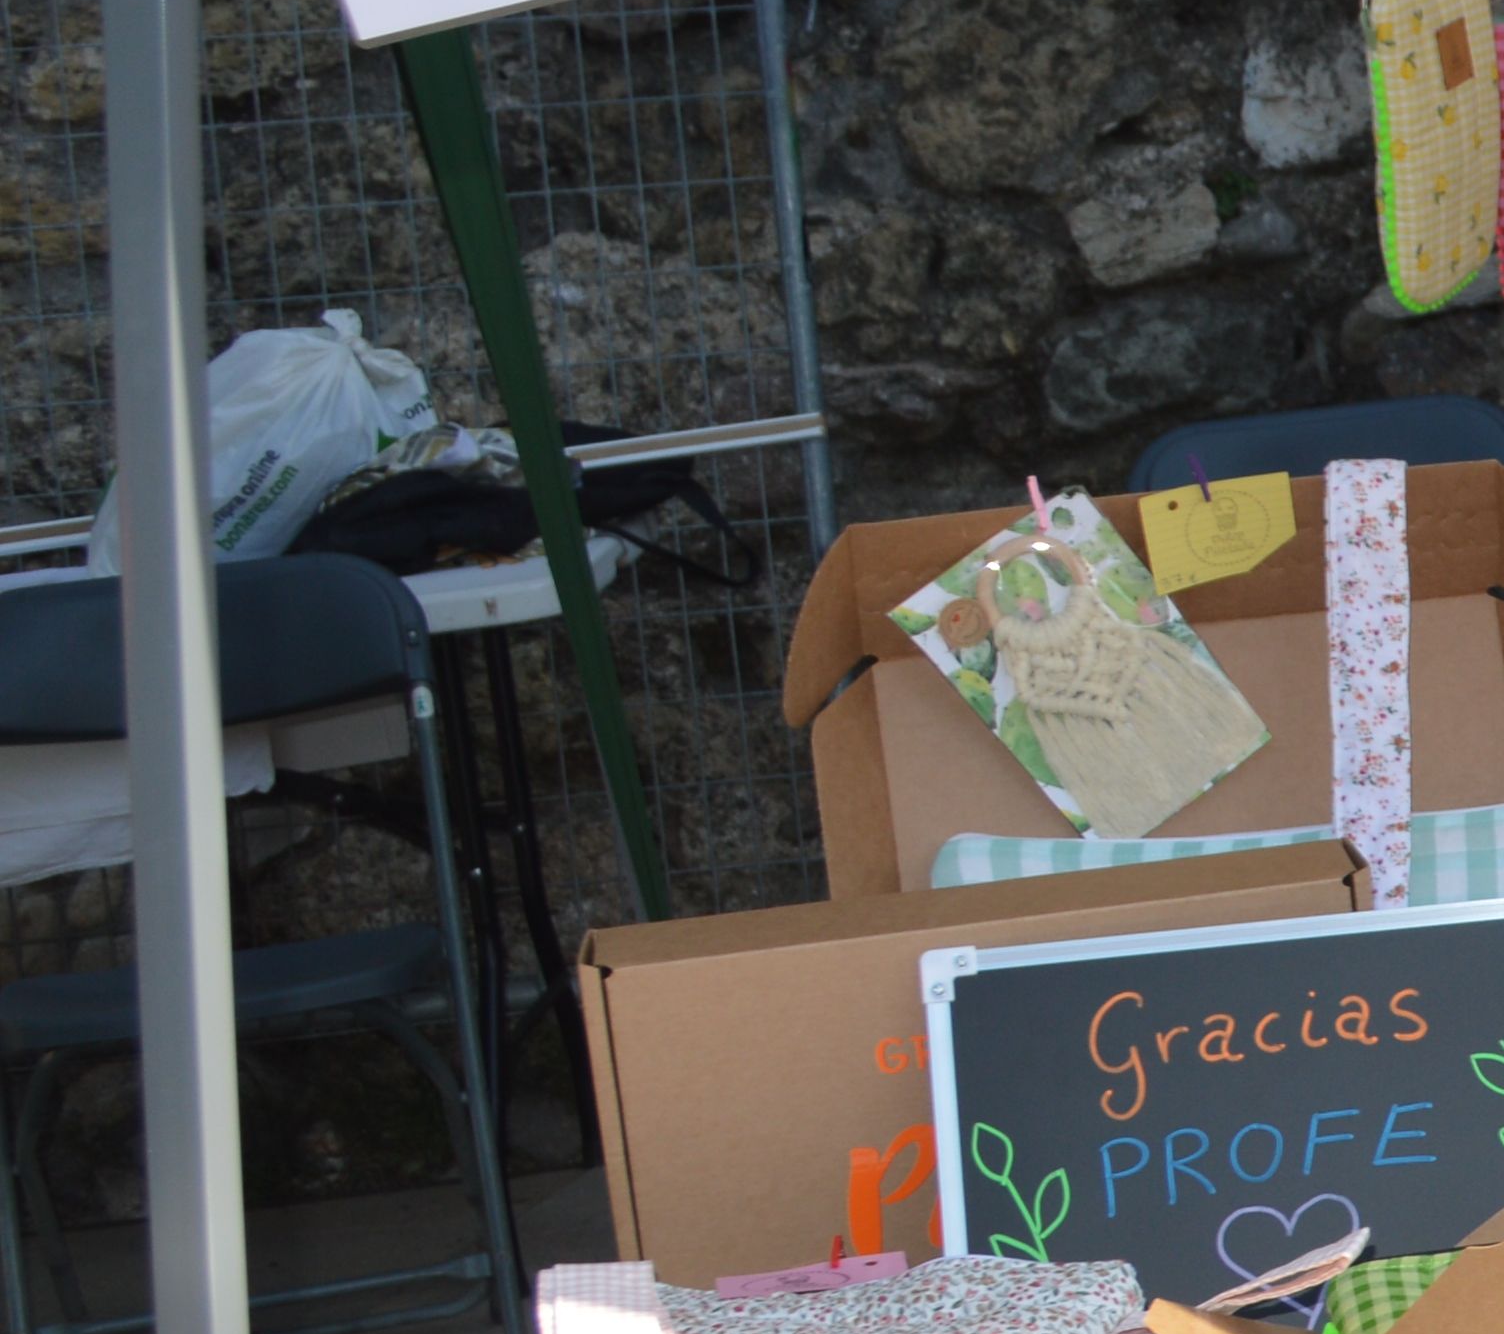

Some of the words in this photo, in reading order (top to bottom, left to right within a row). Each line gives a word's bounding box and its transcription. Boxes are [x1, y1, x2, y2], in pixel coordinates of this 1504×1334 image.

[215, 464, 299, 552] bonarea.com
[241, 447, 281, 497] online
[1087, 988, 1429, 1121] Gracias
[1099, 1100, 1438, 1219] PROFE
